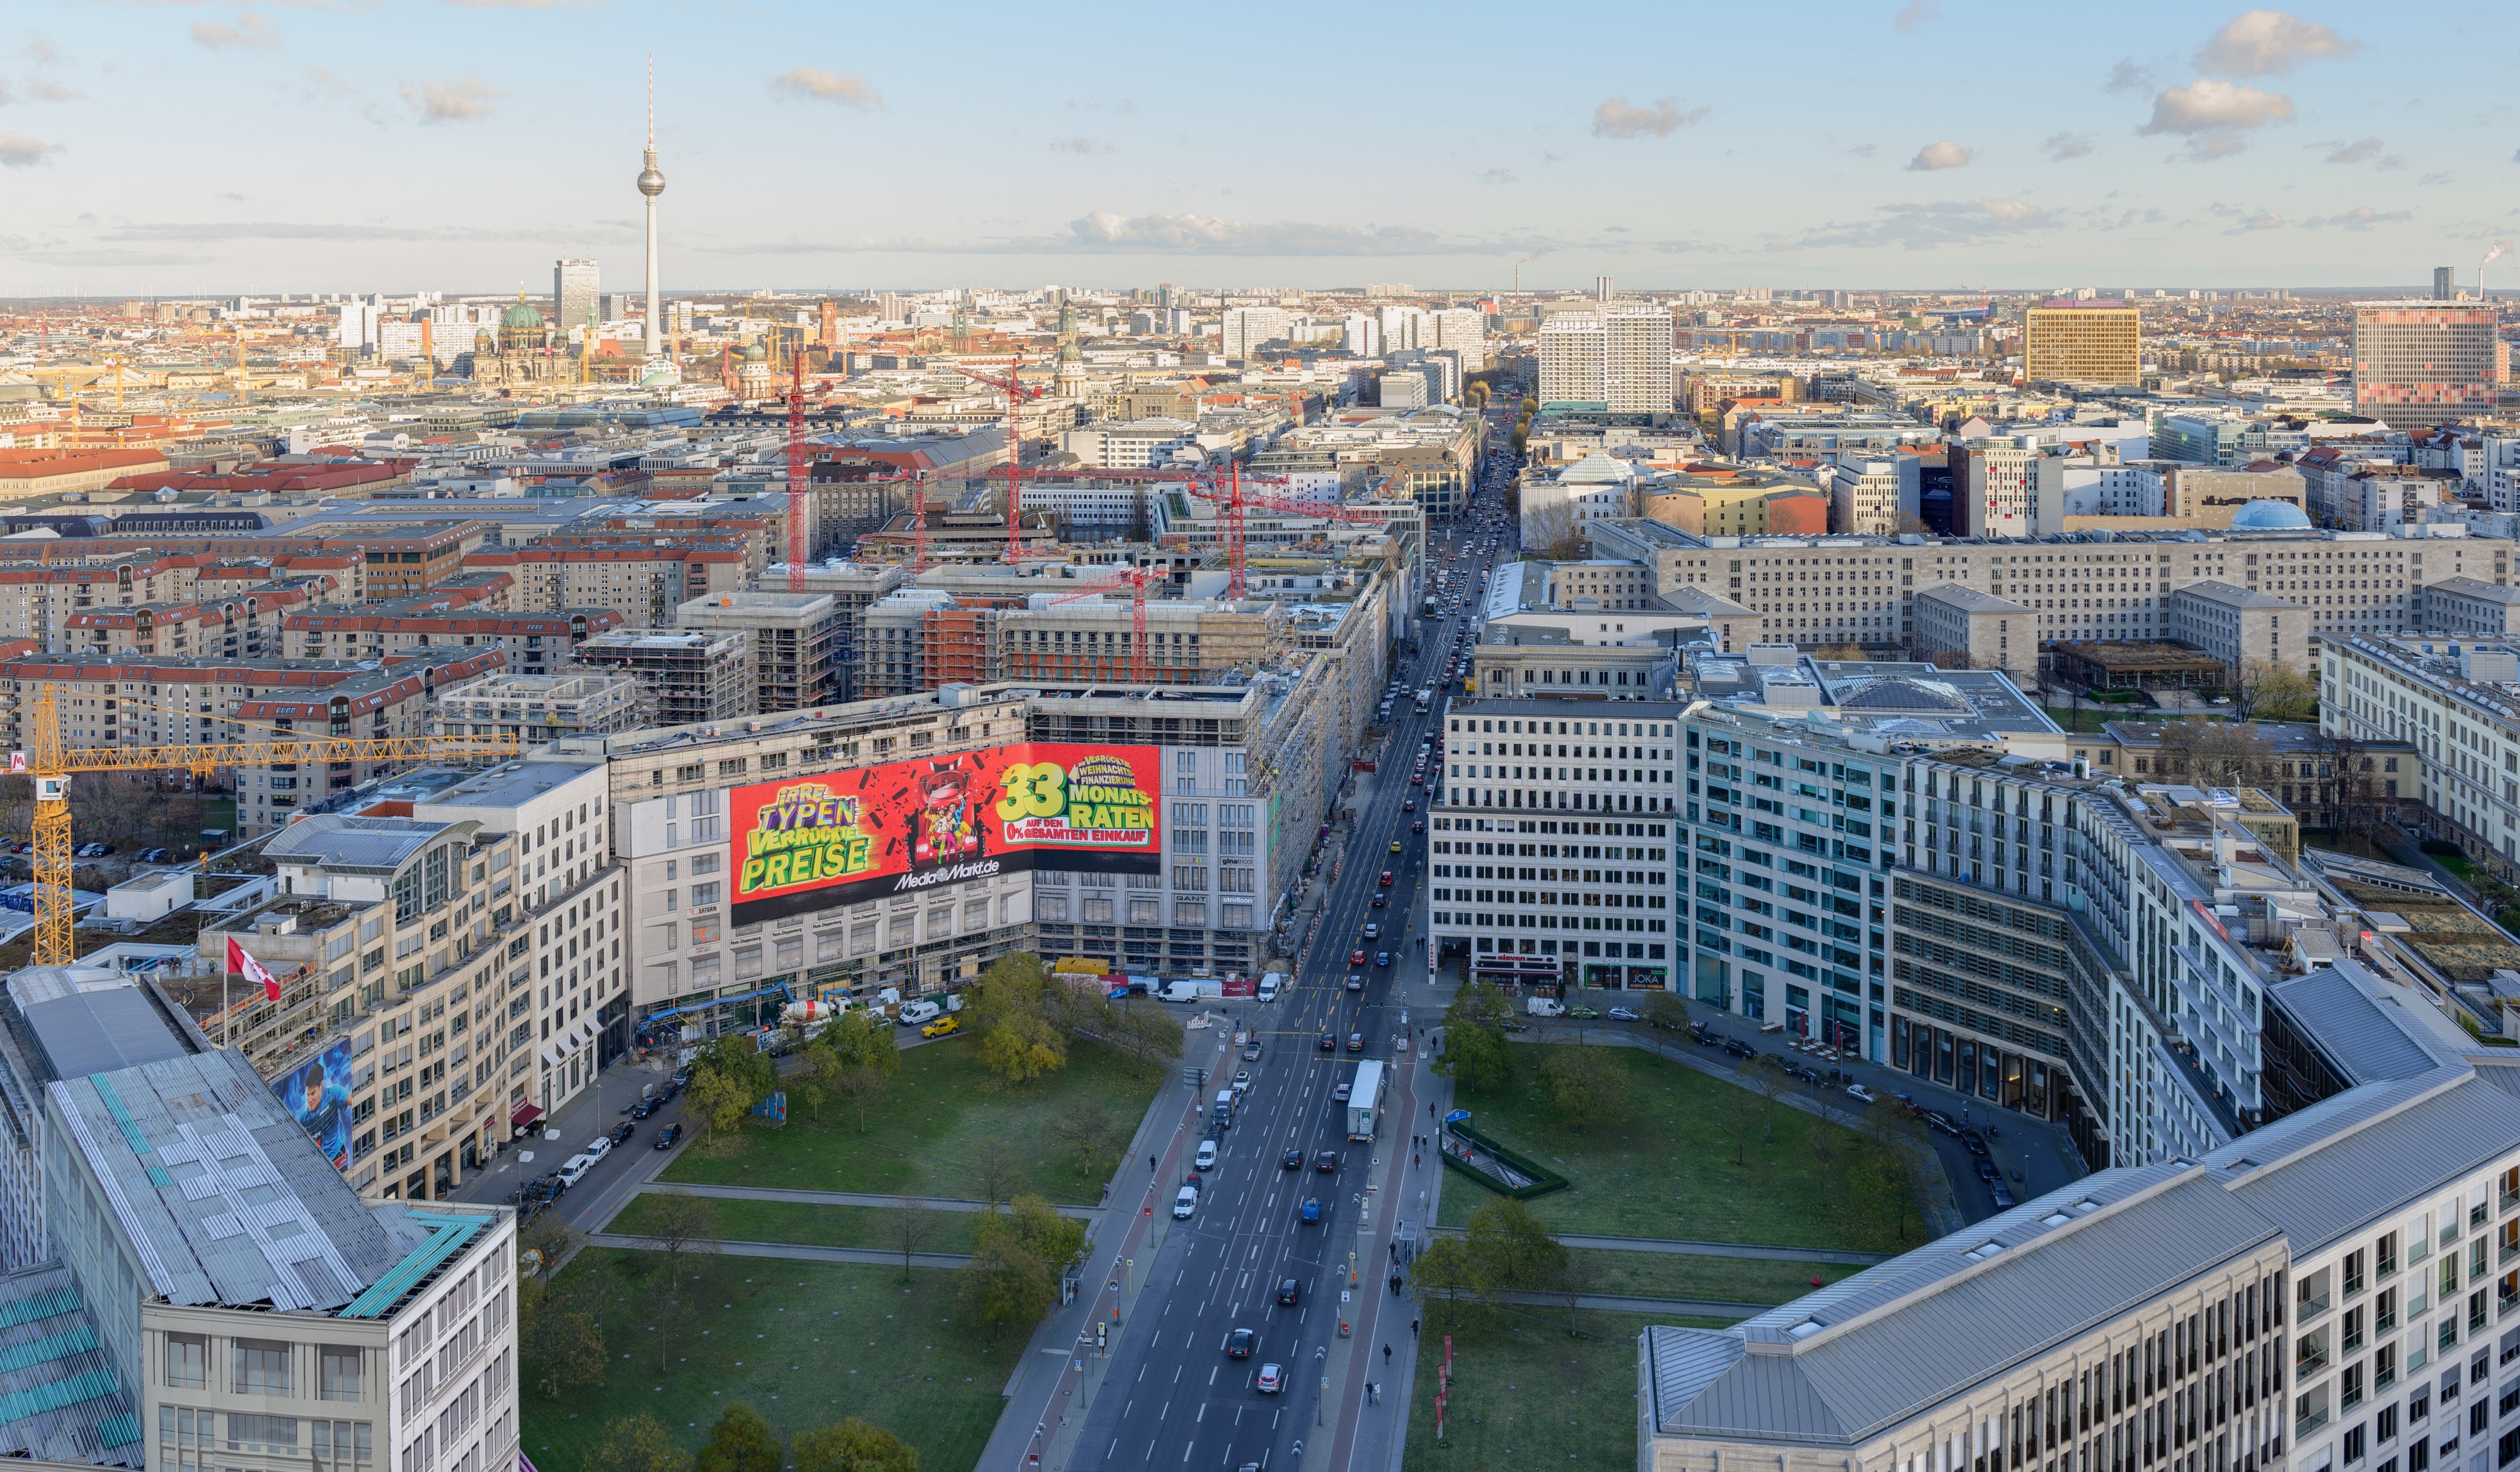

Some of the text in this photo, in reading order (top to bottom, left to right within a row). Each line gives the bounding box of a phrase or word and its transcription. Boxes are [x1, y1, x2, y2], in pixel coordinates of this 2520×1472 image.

[1079, 765, 1135, 777] WEIHNACHTS-
[1085, 755, 1131, 768] VERRÜCKTE
[1081, 775, 1136, 786] FINANZIERUNG
[995, 762, 1066, 821] 33
[1070, 785, 1153, 806] MONATS-
[760, 797, 857, 833] TYPEN
[1026, 819, 1063, 828] AUF DEN
[1070, 803, 1154, 828] RATEN
[749, 826, 857, 857] VERRÜCKTE
[1007, 823, 1024, 840] 0%
[1024, 828, 1088, 841] GESAMTEN
[1092, 830, 1147, 842] EINKAUF
[741, 836, 869, 892] PREISE
[894, 872, 937, 891] Media
[699, 906, 717, 914] SATURN
[1633, 974, 1659, 983] JOKA
